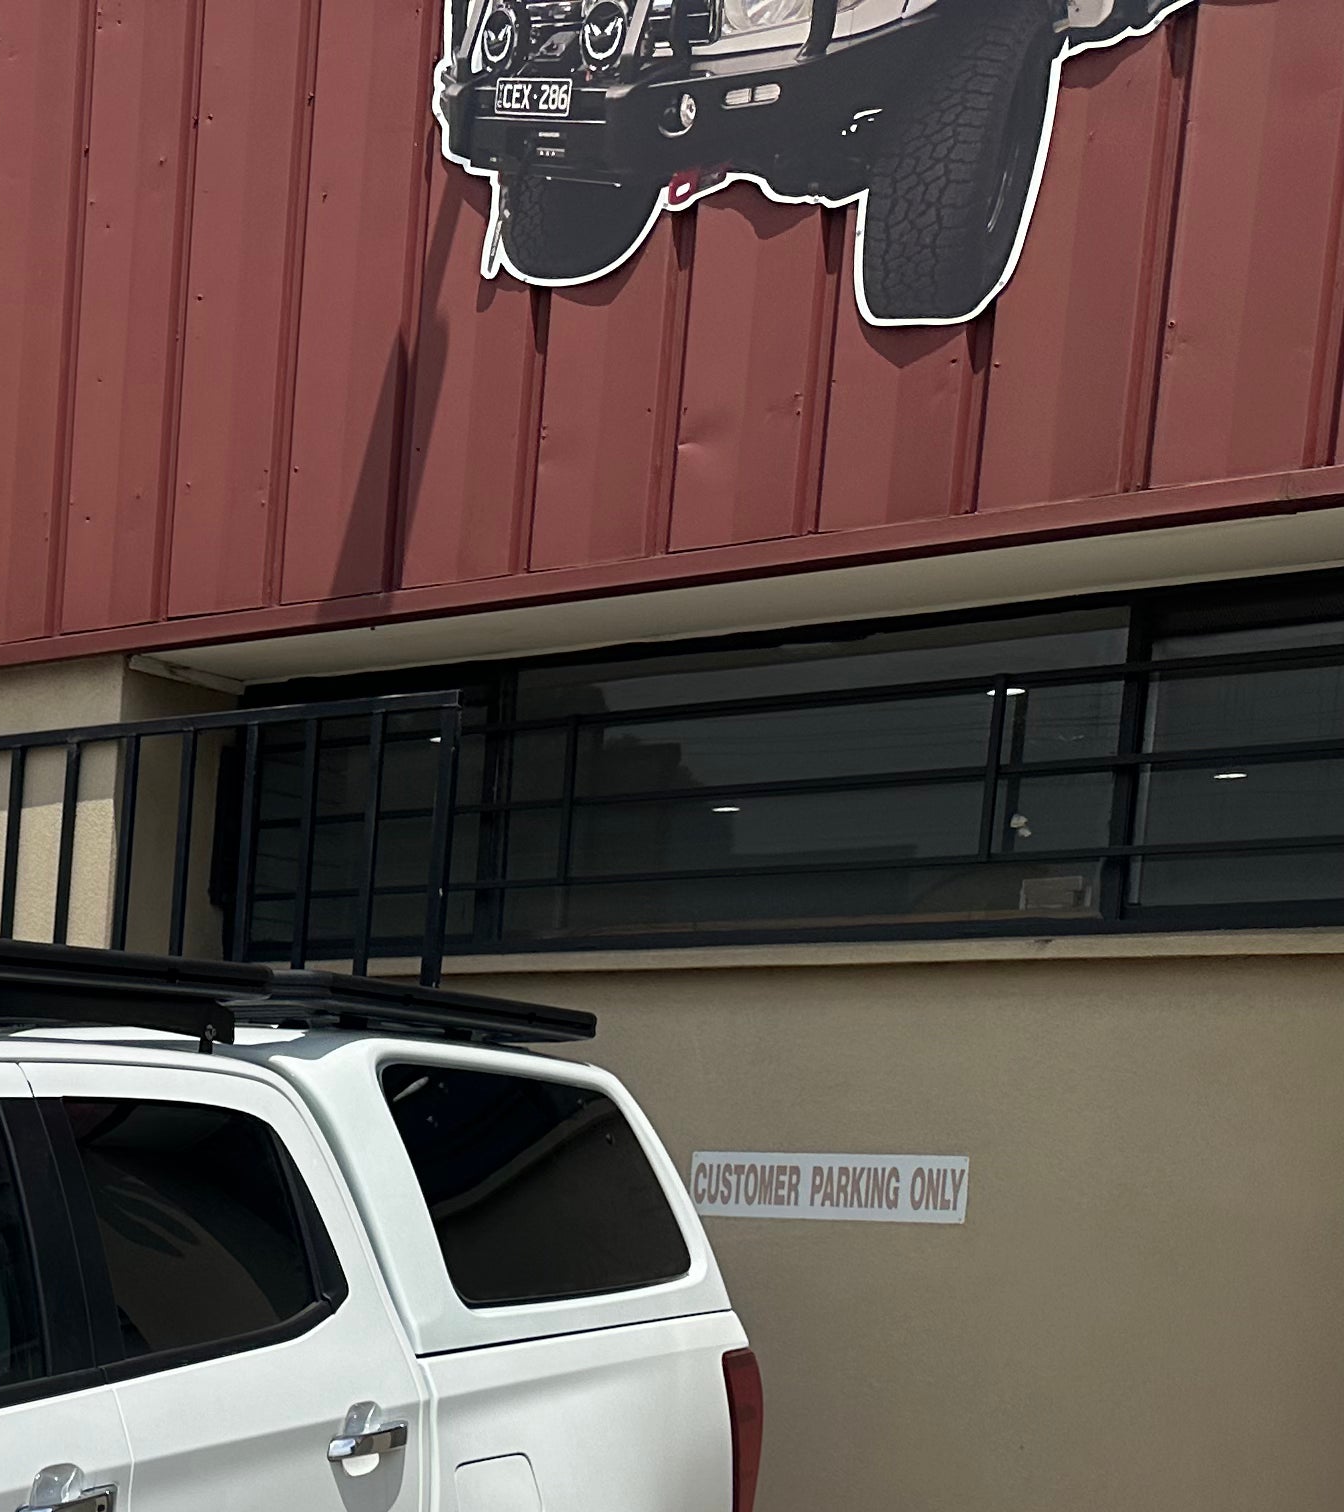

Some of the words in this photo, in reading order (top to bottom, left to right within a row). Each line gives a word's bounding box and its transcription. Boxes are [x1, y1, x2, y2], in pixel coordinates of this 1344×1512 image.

[693, 1163, 801, 1207] CUSTOMER
[809, 1165, 901, 1210] PARKING
[910, 1167, 967, 1211] ONLY
